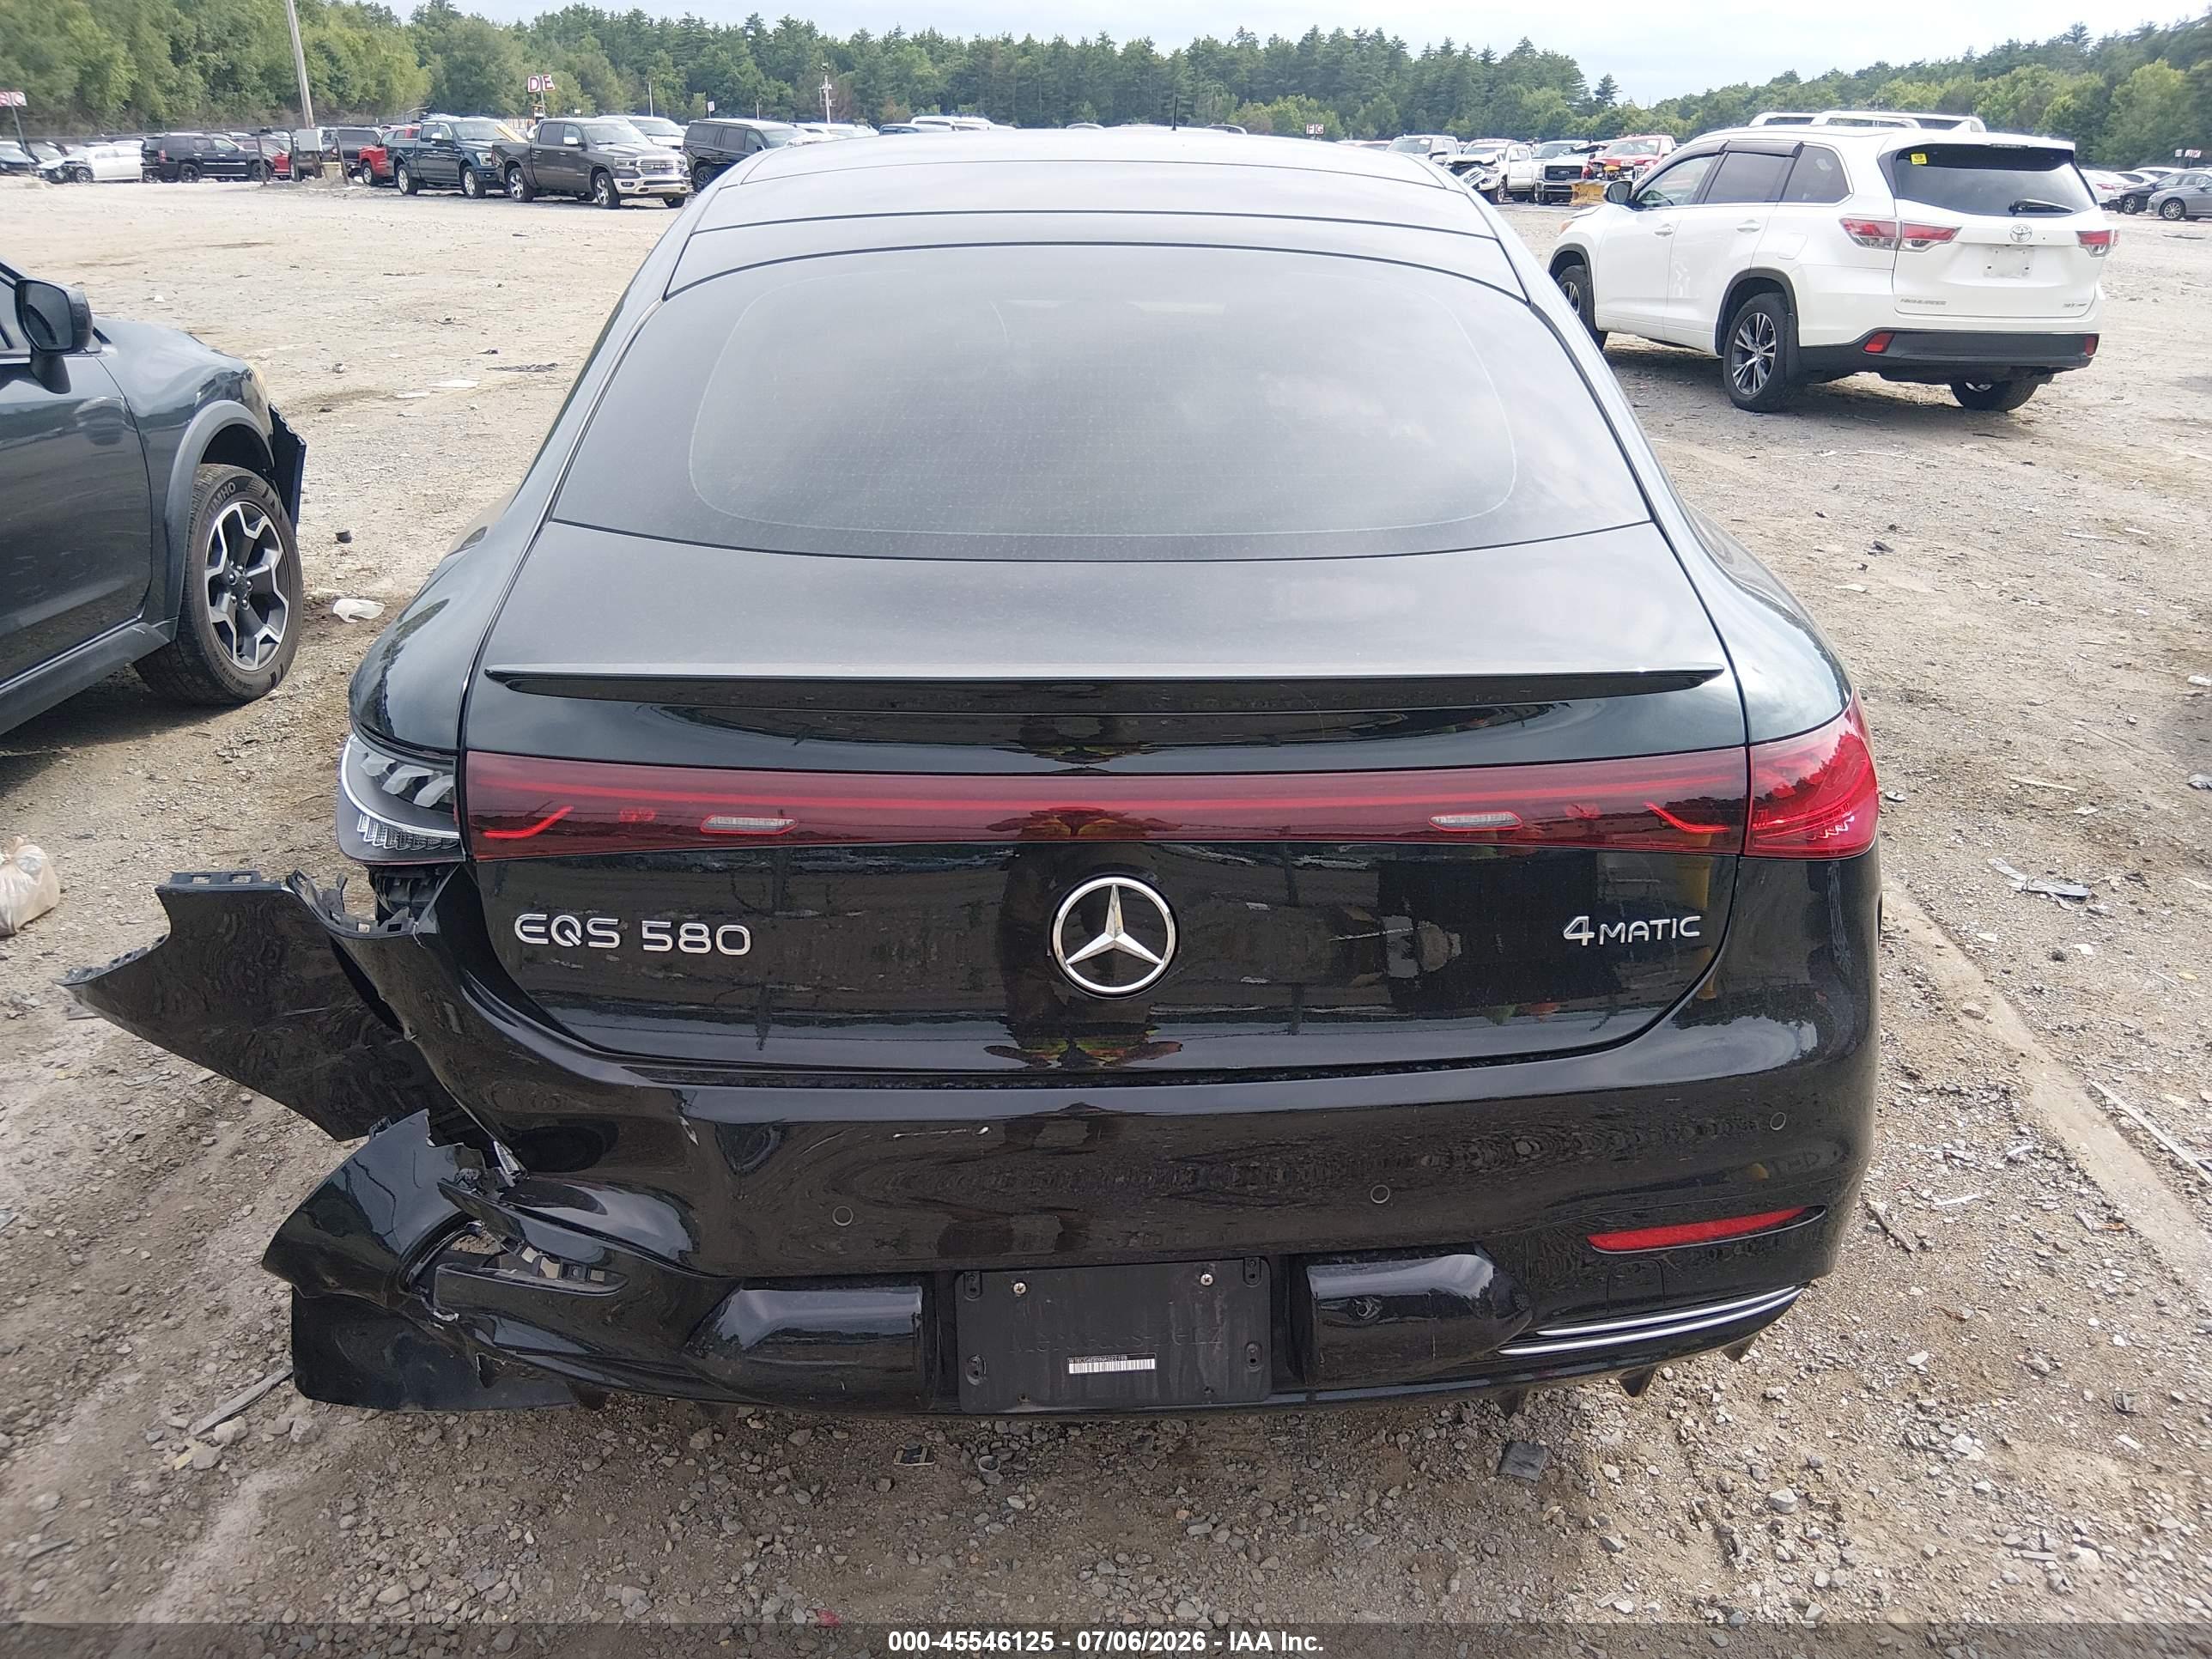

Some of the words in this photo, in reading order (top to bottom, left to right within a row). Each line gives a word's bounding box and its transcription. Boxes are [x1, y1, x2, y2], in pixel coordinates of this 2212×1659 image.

[514, 913, 621, 949] EQS
[641, 920, 751, 956] 580
[1563, 915, 1702, 946] 4MATIC
